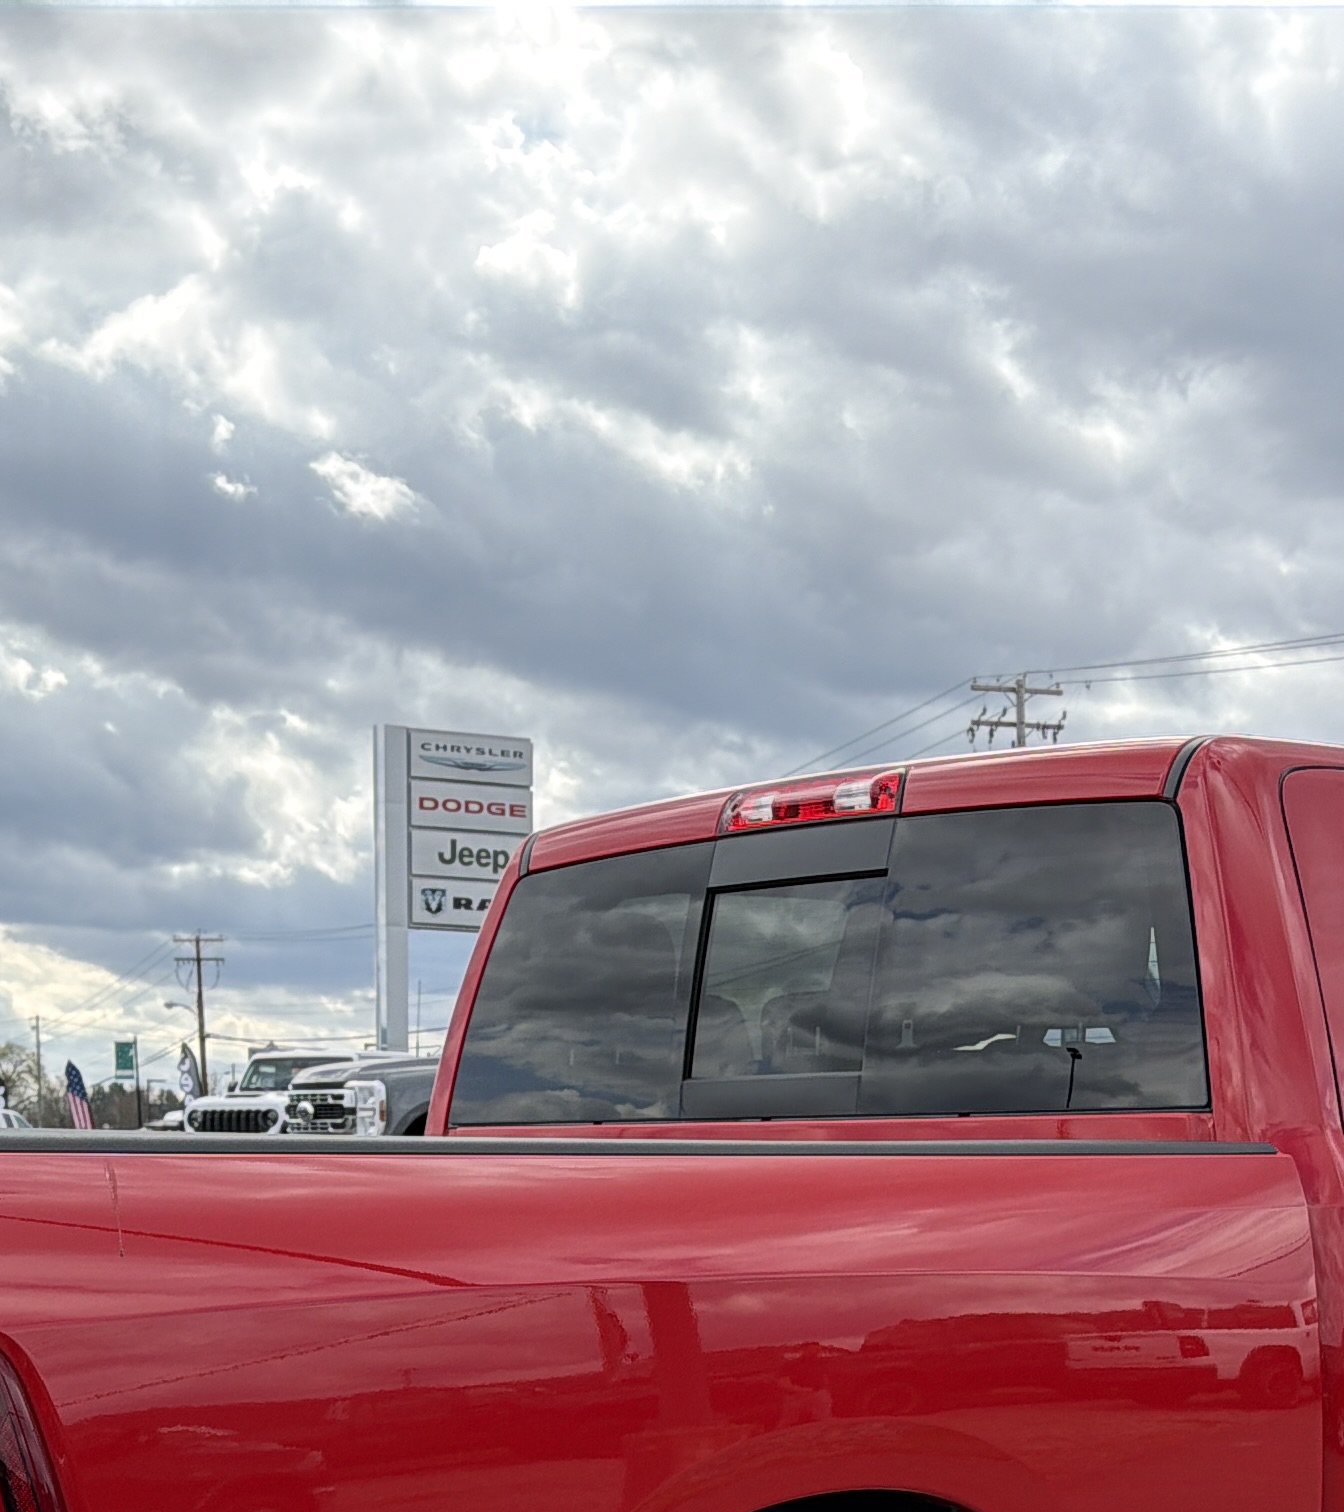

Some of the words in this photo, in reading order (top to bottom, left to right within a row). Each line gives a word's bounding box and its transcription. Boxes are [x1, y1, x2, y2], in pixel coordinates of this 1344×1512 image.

[420, 742, 525, 759] CHRYSLER
[418, 796, 528, 818] DODGE
[438, 838, 510, 874] Jeep
[452, 896, 492, 911] RA
